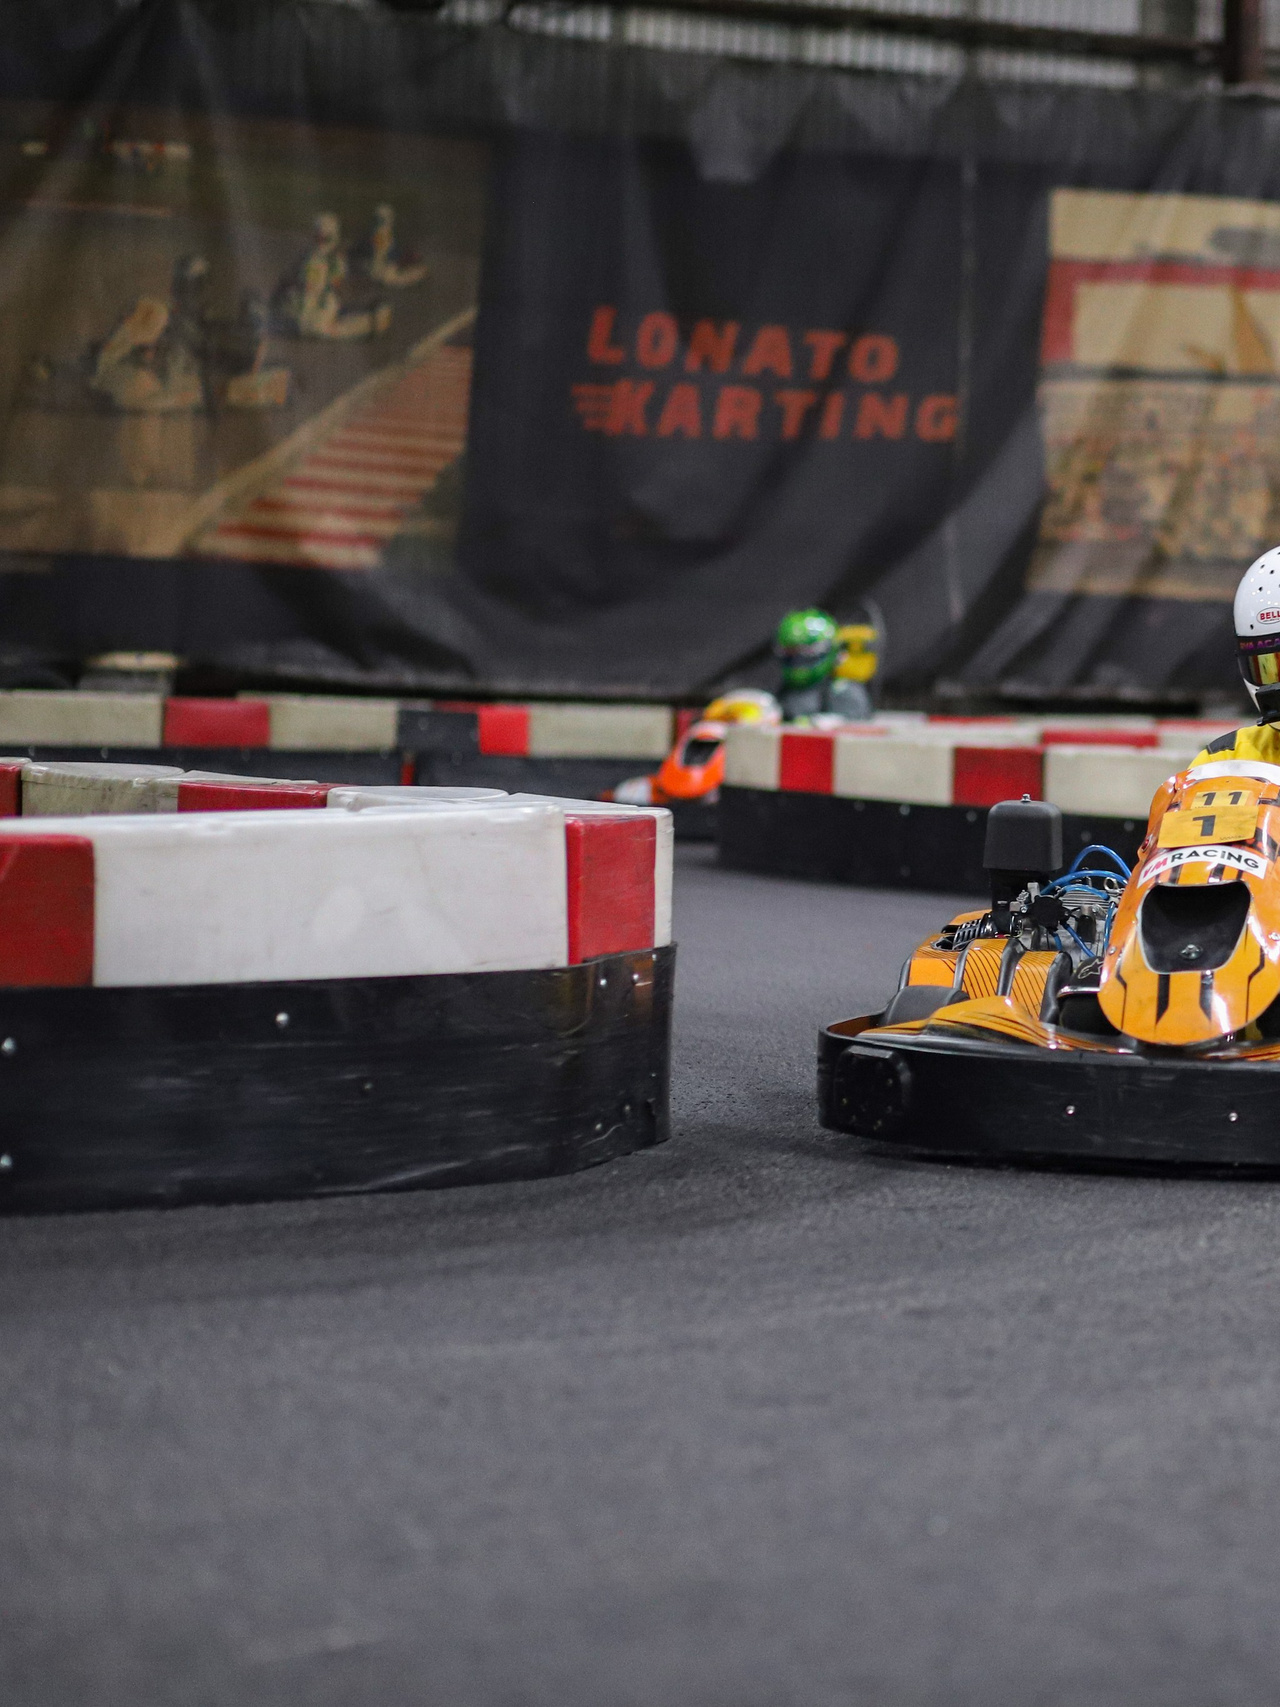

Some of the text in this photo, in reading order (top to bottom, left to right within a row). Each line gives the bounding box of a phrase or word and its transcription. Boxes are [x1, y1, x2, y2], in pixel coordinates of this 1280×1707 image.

[585, 305, 900, 383] LONATO
[600, 377, 960, 443] KARTING
[1202, 791, 1243, 806] 11
[1192, 815, 1216, 837] 1
[1170, 849, 1260, 869] RACING
